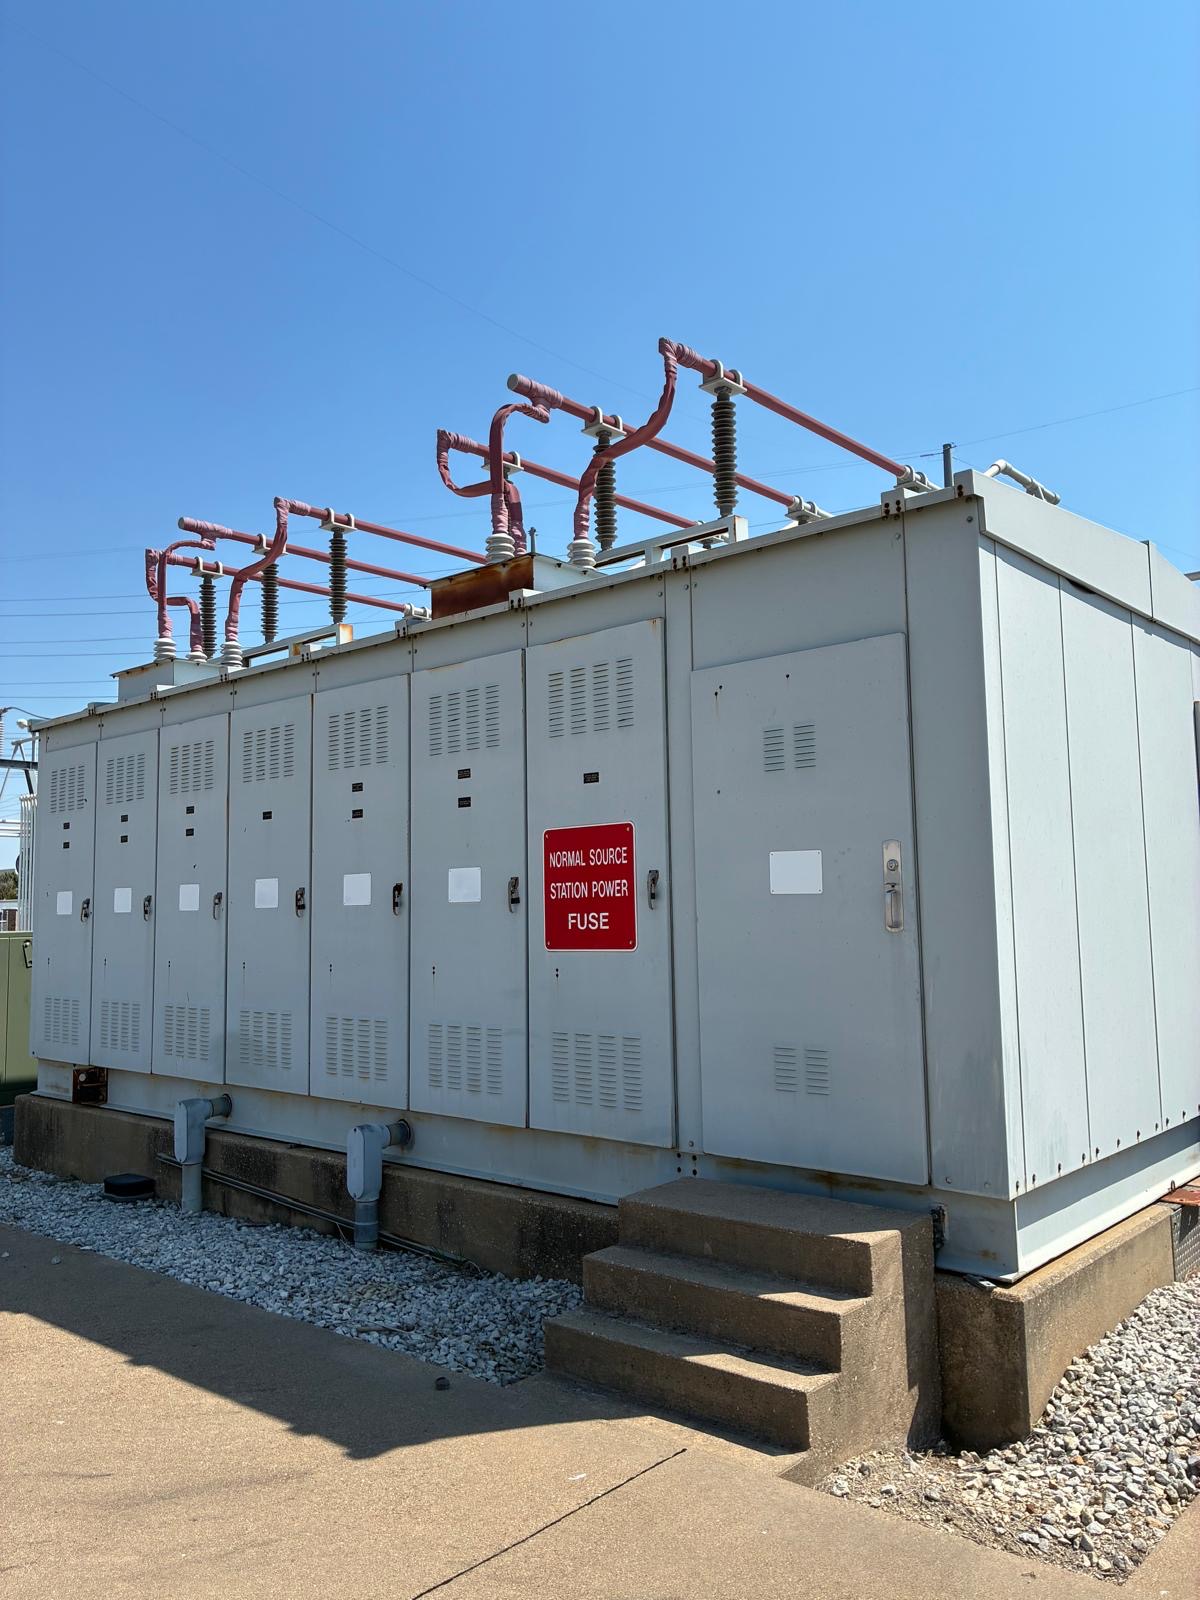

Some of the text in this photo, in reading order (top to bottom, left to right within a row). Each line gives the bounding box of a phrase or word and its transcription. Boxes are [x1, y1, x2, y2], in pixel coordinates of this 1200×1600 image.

[549, 847, 628, 868] NORMAL SOURCE
[550, 879, 629, 900] STATION POWER
[568, 912, 610, 930] FUSE
